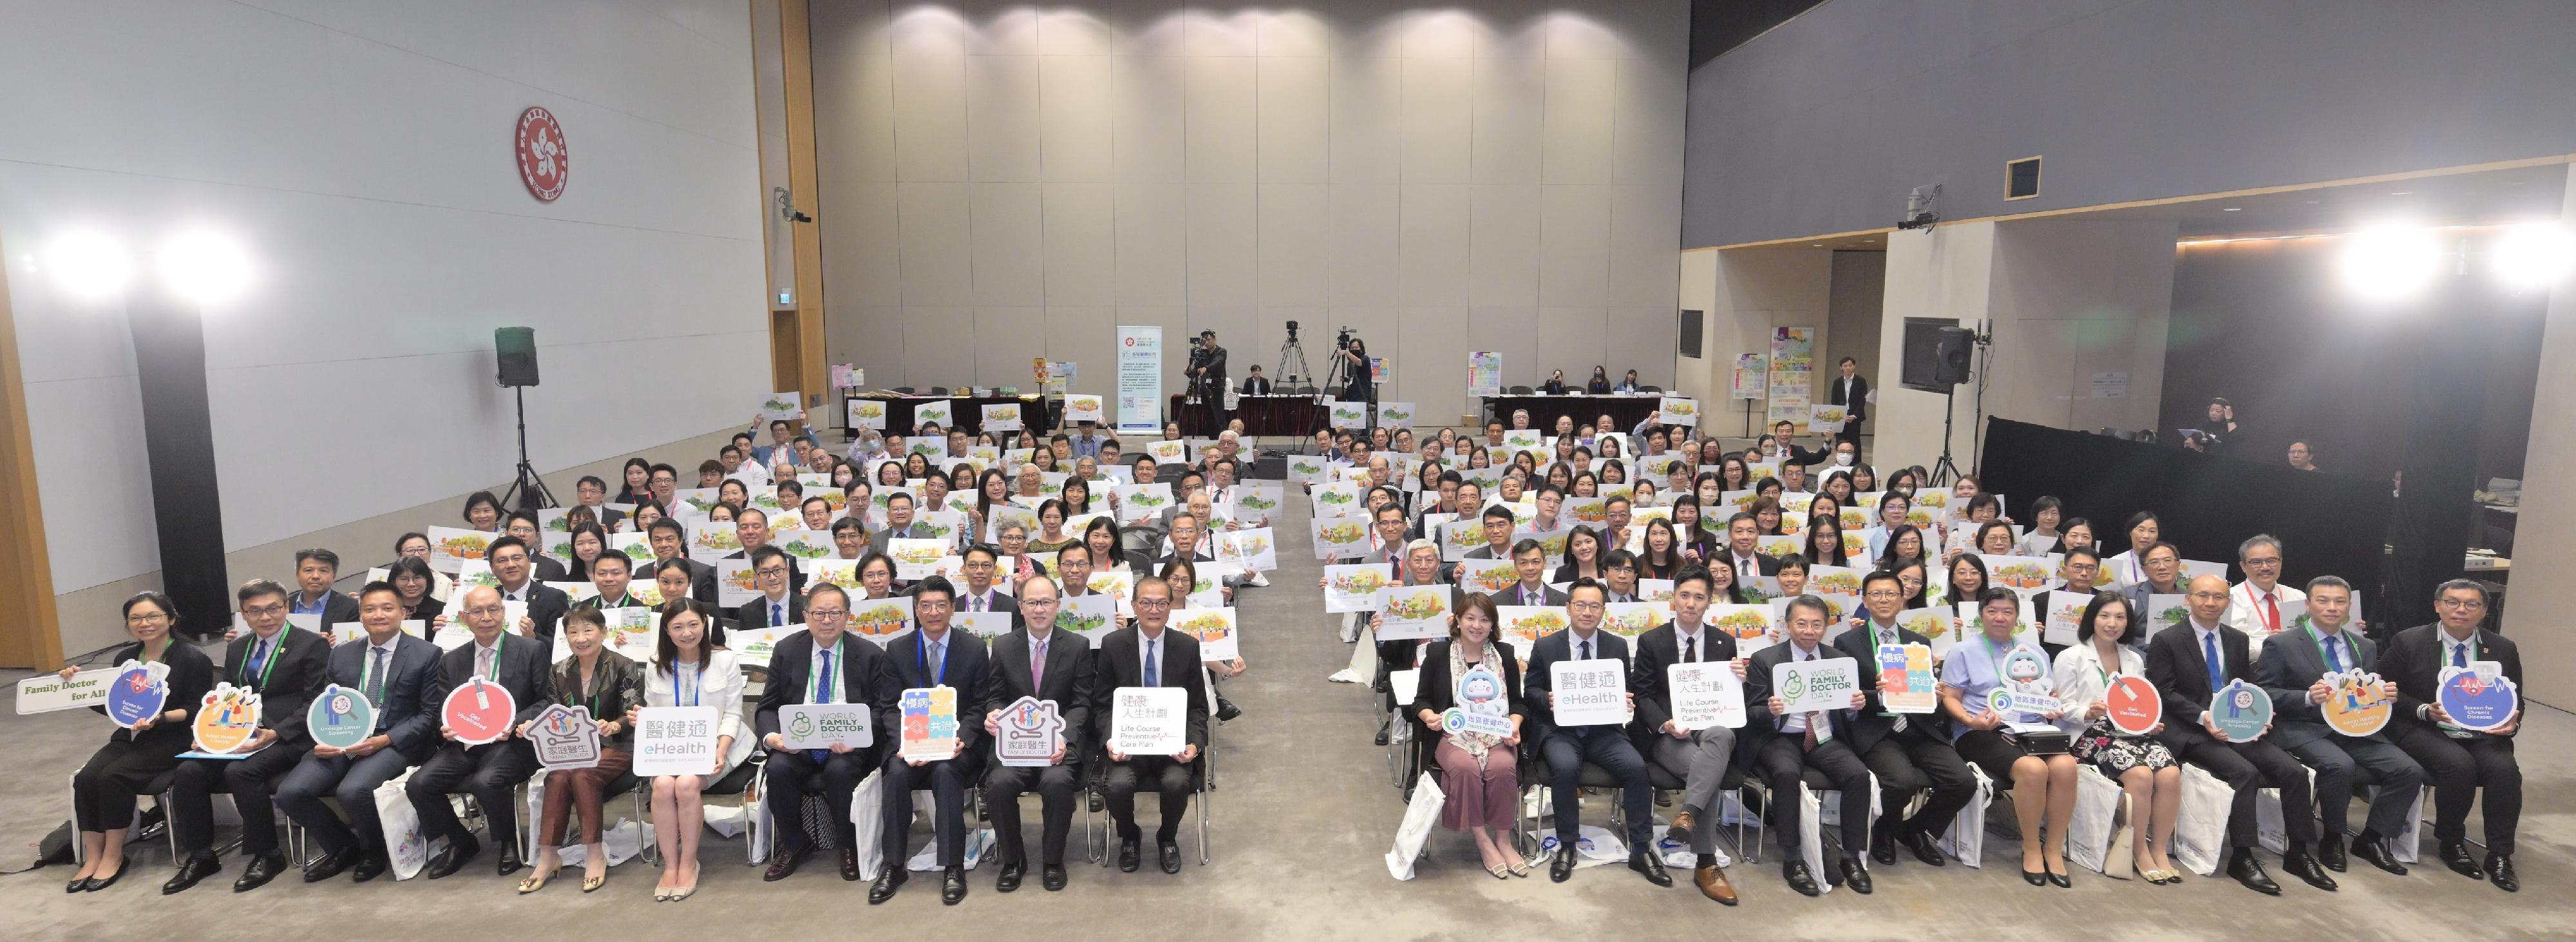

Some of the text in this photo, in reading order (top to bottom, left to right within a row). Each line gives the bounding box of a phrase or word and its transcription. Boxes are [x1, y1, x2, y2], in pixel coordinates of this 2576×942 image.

[532, 181, 560, 198] HONG KONG
[1883, 652, 1904, 663] 慢病
[1676, 669, 1701, 682] 健康
[1811, 668, 1844, 677] WORLD
[1560, 671, 1616, 690] 醫健通
[1811, 675, 1846, 684] FAMILY
[1910, 676, 1930, 686] 共治
[24, 680, 97, 695] Family Doctor
[1680, 680, 1723, 694] 人生計劃
[1811, 682, 1851, 692] DOCTOR
[71, 689, 106, 700] for All
[1562, 692, 1617, 704] eHealth
[906, 698, 928, 709] 慢病
[1121, 695, 1147, 707] 健康
[2015, 695, 2058, 707] 地區康健中心
[1122, 708, 1167, 718] 人生計劃
[457, 712, 488, 731] Vaccinated
[931, 721, 952, 732] 共治
[1468, 715, 1510, 729] 地區康健中心
[646, 720, 707, 738] 醫健通
[547, 744, 588, 755] 家庭醫生
[645, 742, 706, 755] eHealth
[1008, 740, 1046, 749] 家庭醫生
